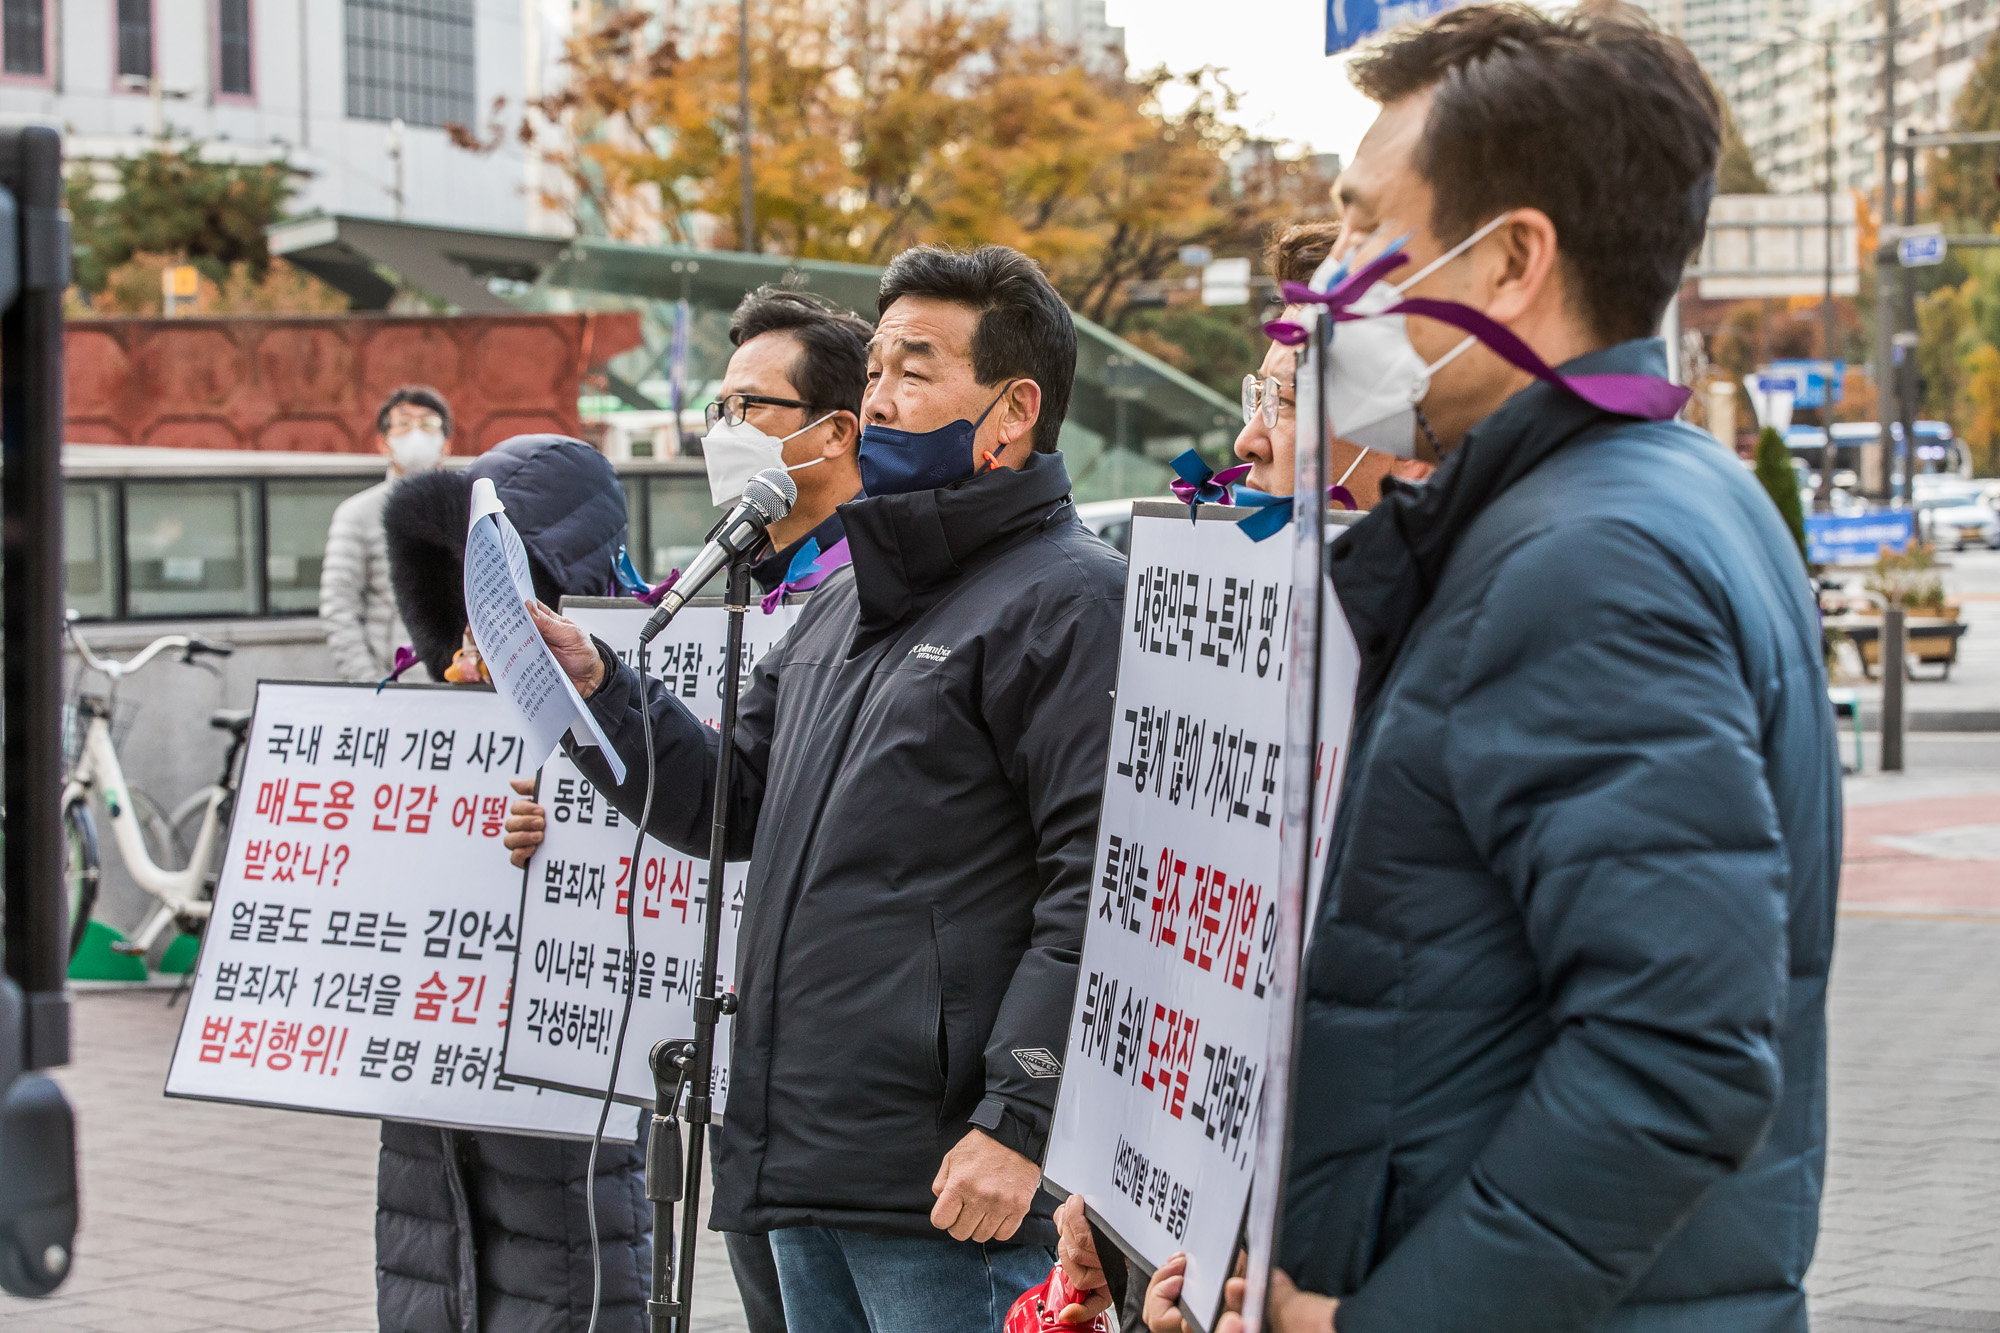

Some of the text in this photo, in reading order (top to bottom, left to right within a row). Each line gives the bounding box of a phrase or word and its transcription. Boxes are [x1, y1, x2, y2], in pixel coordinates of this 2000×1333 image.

[1134, 565, 1199, 662] 대한민국
[1200, 577, 1254, 673] 노른자
[909, 643, 951, 656] Columbia
[267, 724, 324, 765] 국내
[333, 726, 389, 769] 최대
[400, 728, 455, 771] 기업
[1117, 705, 1170, 798] 그렇게
[1169, 714, 1206, 811] 많이
[1205, 719, 1257, 823] 가지고
[255, 776, 508, 838] 매도용 인감 어떻
[243, 840, 350, 887] 받았나?
[544, 859, 606, 911] 범죄자
[229, 901, 312, 945] 얼굴도
[322, 910, 408, 953] 모르는
[1099, 834, 1149, 934] 롯데는
[1149, 847, 1187, 948] 위조
[1183, 864, 1262, 991] 전문기업
[213, 961, 298, 1007] 범죄자
[313, 971, 402, 1016] 12년을
[413, 971, 487, 1025] 숨긴
[534, 938, 594, 990] 이나라
[198, 1015, 349, 1077] 범죄행위!
[360, 1035, 421, 1082] 분명
[526, 998, 613, 1056] 각성하라!
[1081, 971, 1118, 1066] 뒤에
[1113, 986, 1149, 1086] 숨어
[1141, 1002, 1200, 1121] 도적질
[1148, 1166, 1170, 1224] 직원
